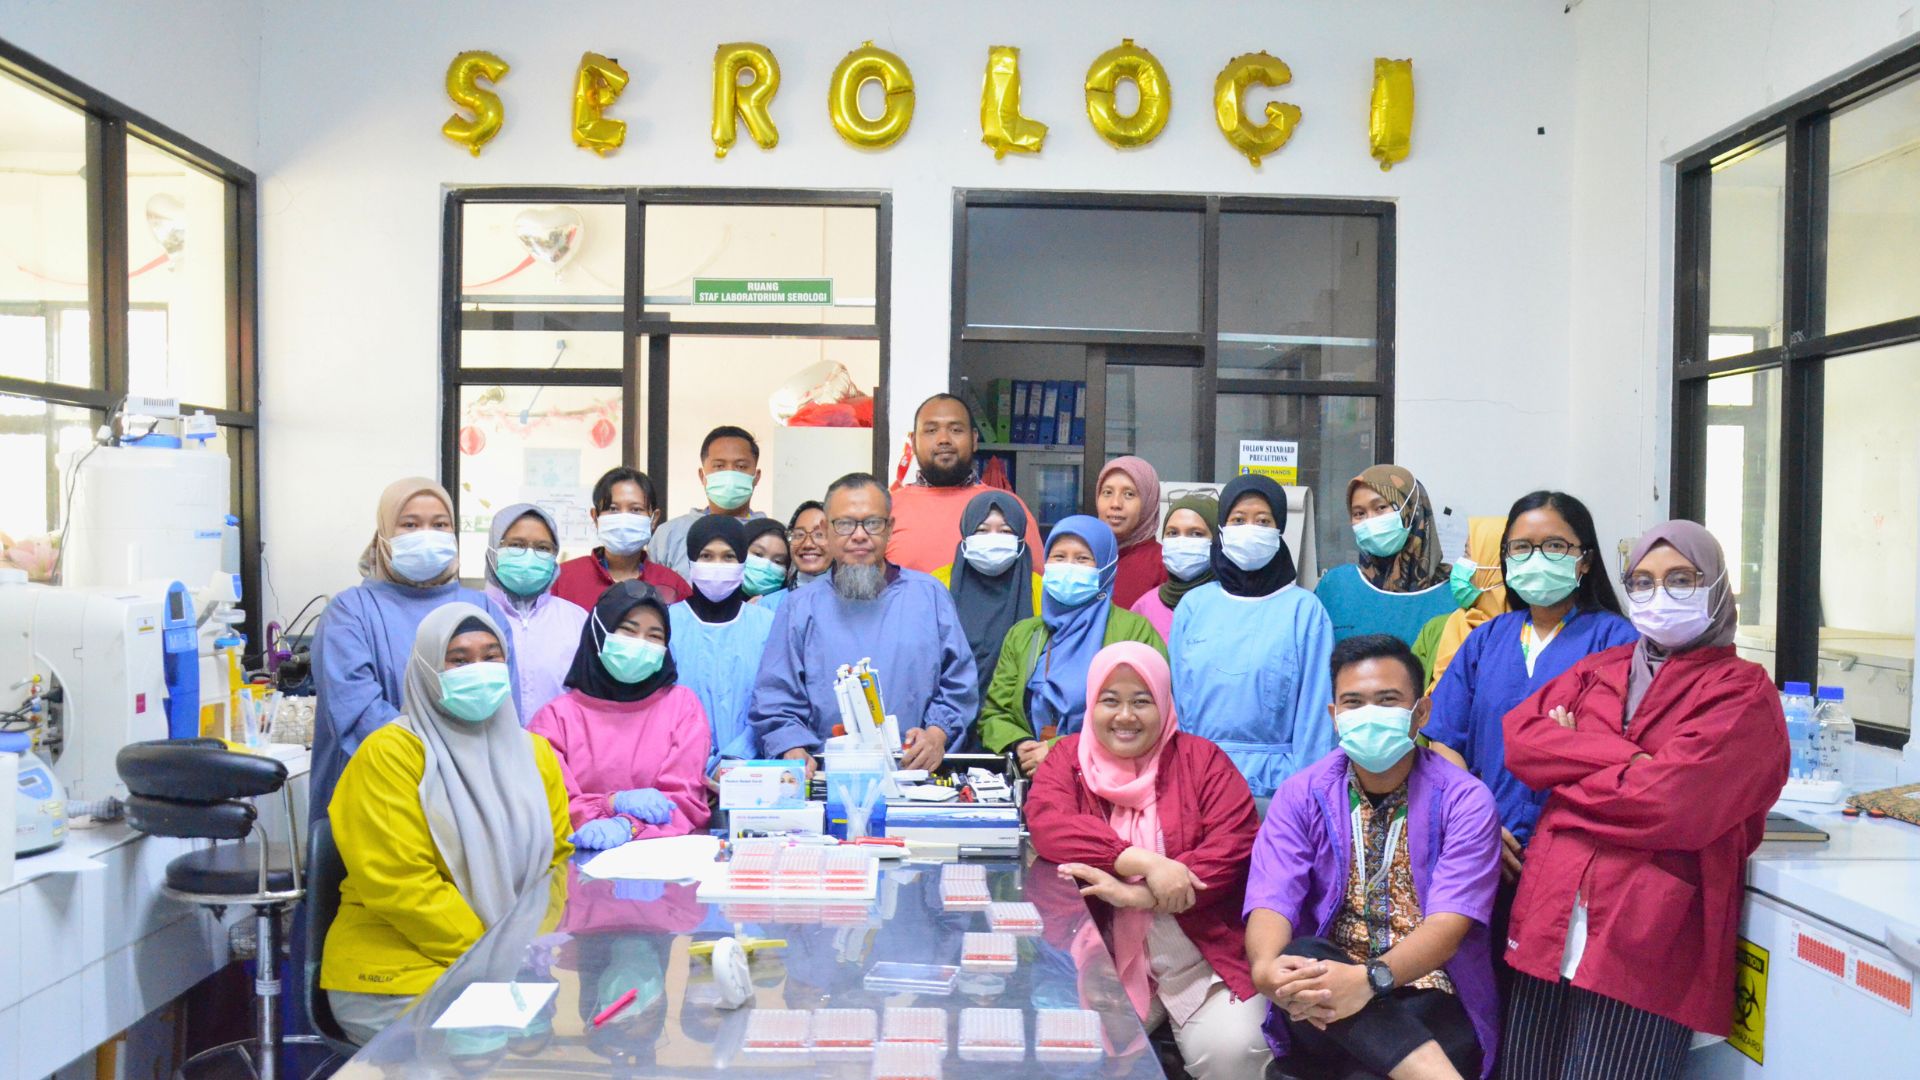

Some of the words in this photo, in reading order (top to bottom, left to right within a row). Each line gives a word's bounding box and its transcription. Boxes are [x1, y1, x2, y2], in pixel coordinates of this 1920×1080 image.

[747, 282, 779, 291] RUANG
[699, 292, 719, 302] STAF
[721, 292, 785, 302] LABORATORIUM
[787, 292, 827, 302] SEROLOGI
[1265, 445, 1295, 453] STANDARD
[1249, 454, 1288, 462] PRECAUTIONS
